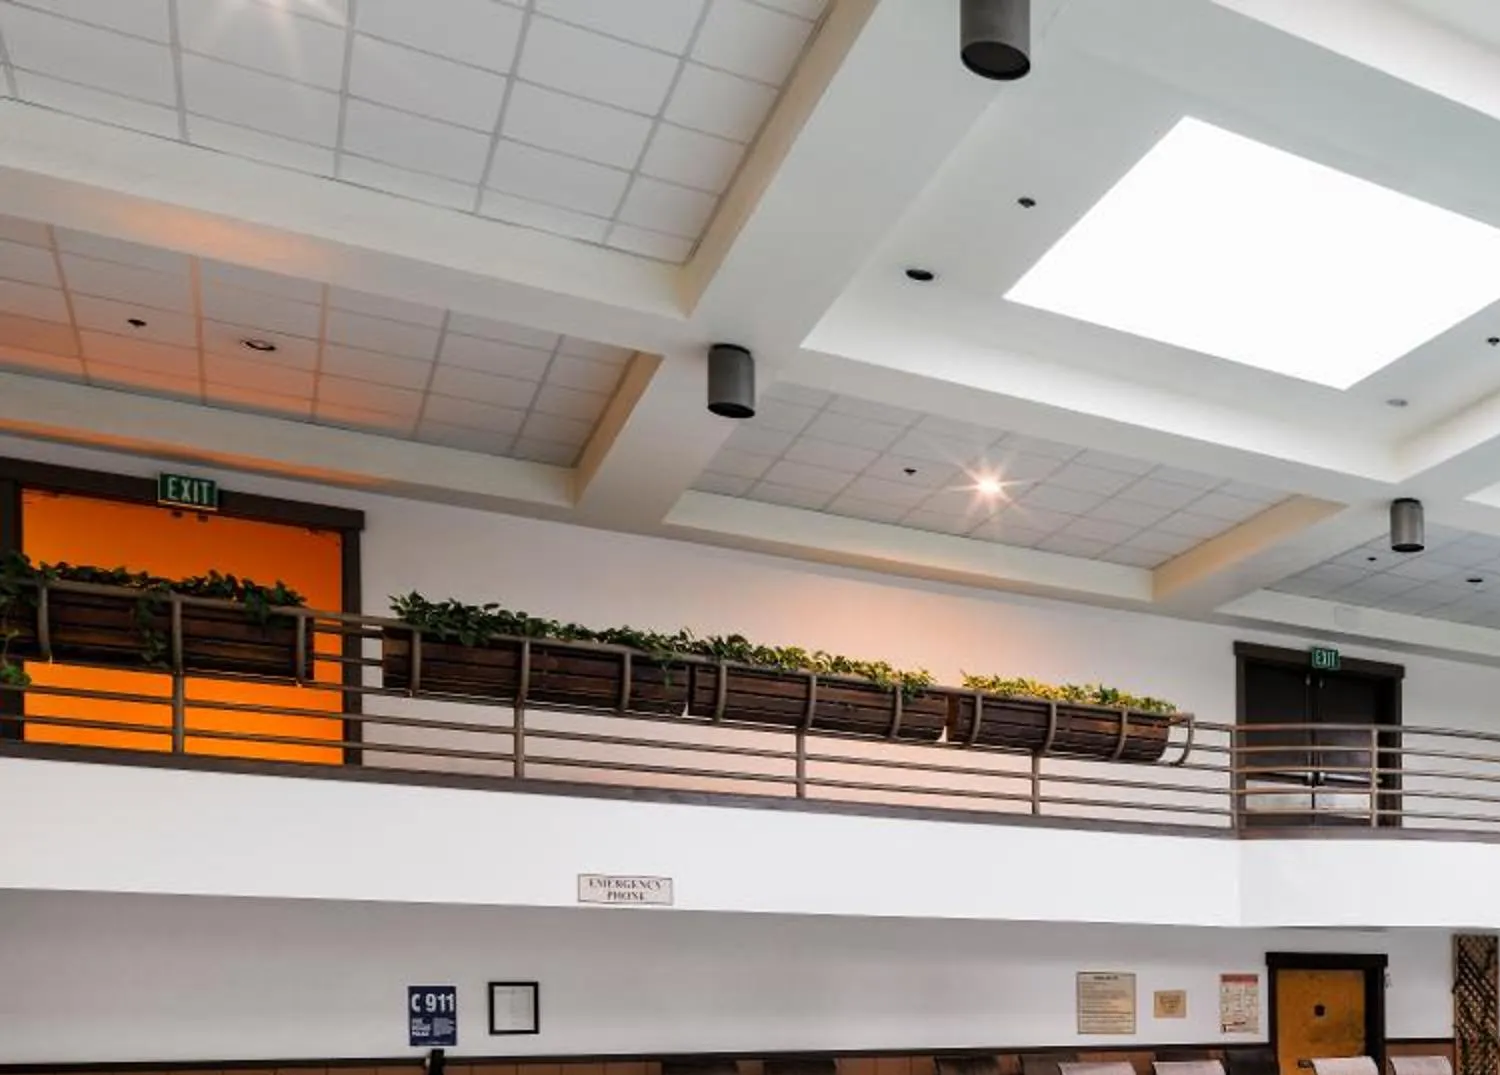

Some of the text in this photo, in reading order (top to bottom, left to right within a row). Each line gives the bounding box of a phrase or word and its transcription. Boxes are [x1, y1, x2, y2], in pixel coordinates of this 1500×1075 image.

[168, 477, 209, 504] EXIT
[589, 879, 661, 889] EMERGENCY
[607, 891, 644, 901] PHONE
[425, 993, 455, 1012] 911
